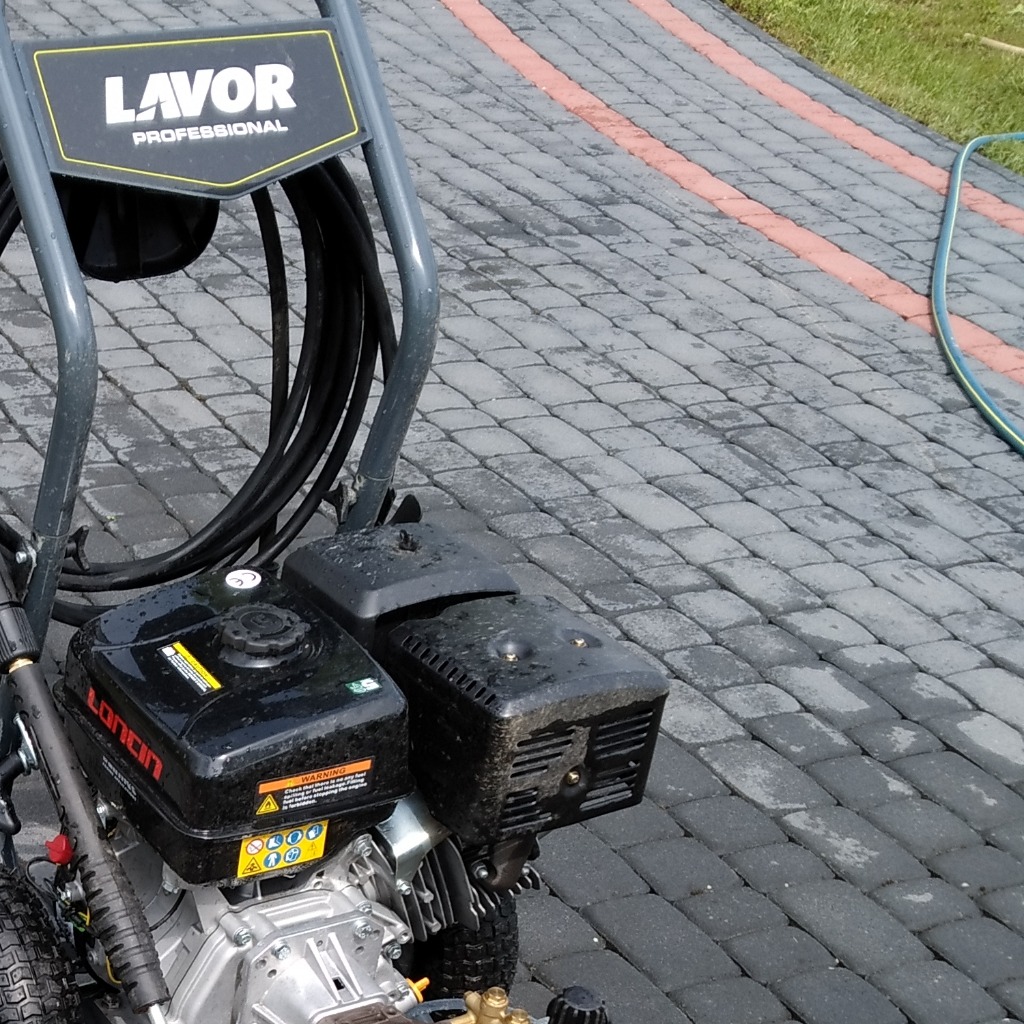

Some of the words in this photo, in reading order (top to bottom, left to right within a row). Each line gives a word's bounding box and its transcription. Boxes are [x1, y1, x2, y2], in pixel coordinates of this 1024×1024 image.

[105, 63, 297, 124] LAVOR
[132, 119, 288, 145] PROFESSIONAL
[302, 768, 346, 782] WARNING
[315, 780, 329, 788] there
[344, 774, 354, 782] any
[298, 793, 312, 801] before
[313, 789, 338, 798] stopping
[312, 785, 323, 793] fuel
[289, 799, 317, 809] forbidden.
